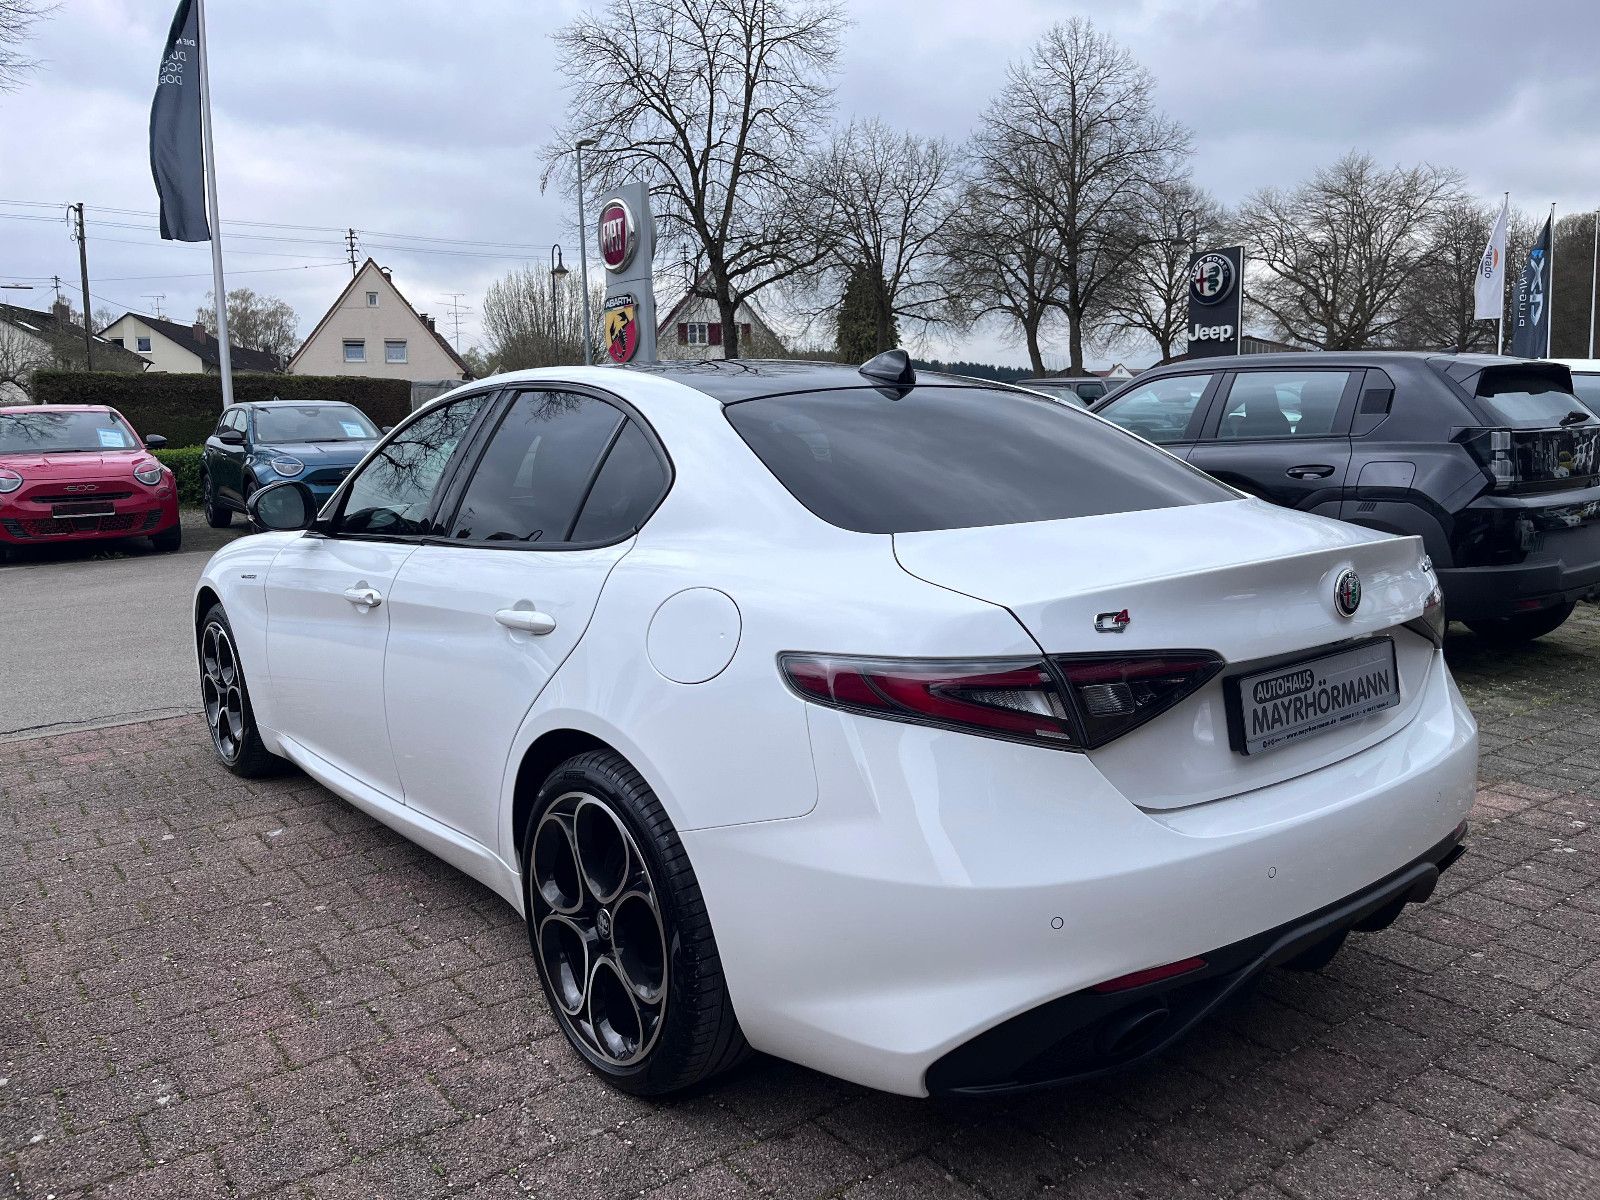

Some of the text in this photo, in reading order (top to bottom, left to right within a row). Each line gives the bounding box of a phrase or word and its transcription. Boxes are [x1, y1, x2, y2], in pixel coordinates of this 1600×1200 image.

[602, 217, 624, 253] FIAT
[1190, 256, 1230, 282] ALFA ROMEO
[605, 296, 632, 307] ABARTH
[1256, 671, 1313, 701] AUTOHAUS
[1252, 669, 1390, 736] MAYRHÖRMANN
